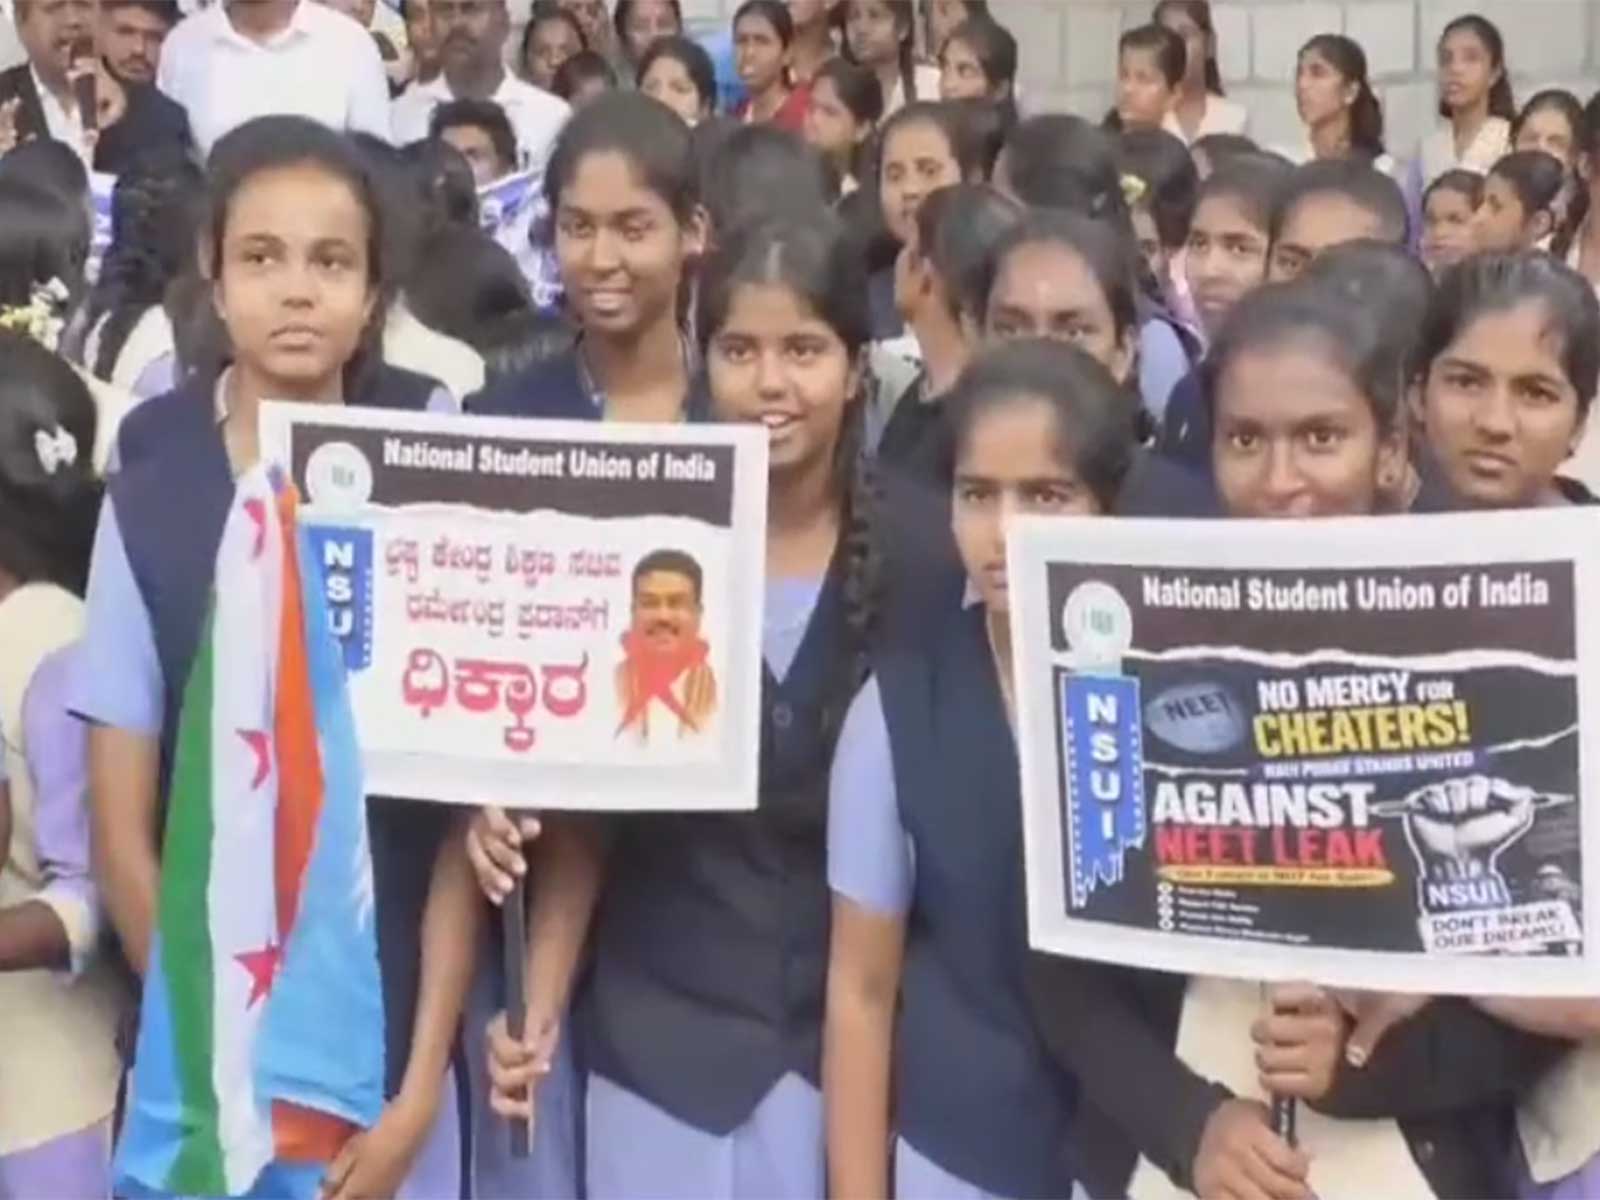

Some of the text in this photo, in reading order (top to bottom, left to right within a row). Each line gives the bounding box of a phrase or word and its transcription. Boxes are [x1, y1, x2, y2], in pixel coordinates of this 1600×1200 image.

[383, 438, 716, 481] National Student Union of India
[323, 539, 354, 636] NSU
[1142, 573, 1550, 611] National Student Union of India
[402, 647, 590, 752] ಧಿಕ್ಕಾರ
[1257, 672, 1455, 710] NO MERCY FOR
[1253, 700, 1471, 757] CHEATERS!
[1086, 692, 1121, 840] NSUI
[1152, 782, 1376, 828] AGAINST
[1155, 827, 1385, 869] NEET LEAK
[1428, 880, 1504, 907] NSUI
[1432, 907, 1559, 933] DON'T BREAK
[1434, 932, 1477, 950] OUR
